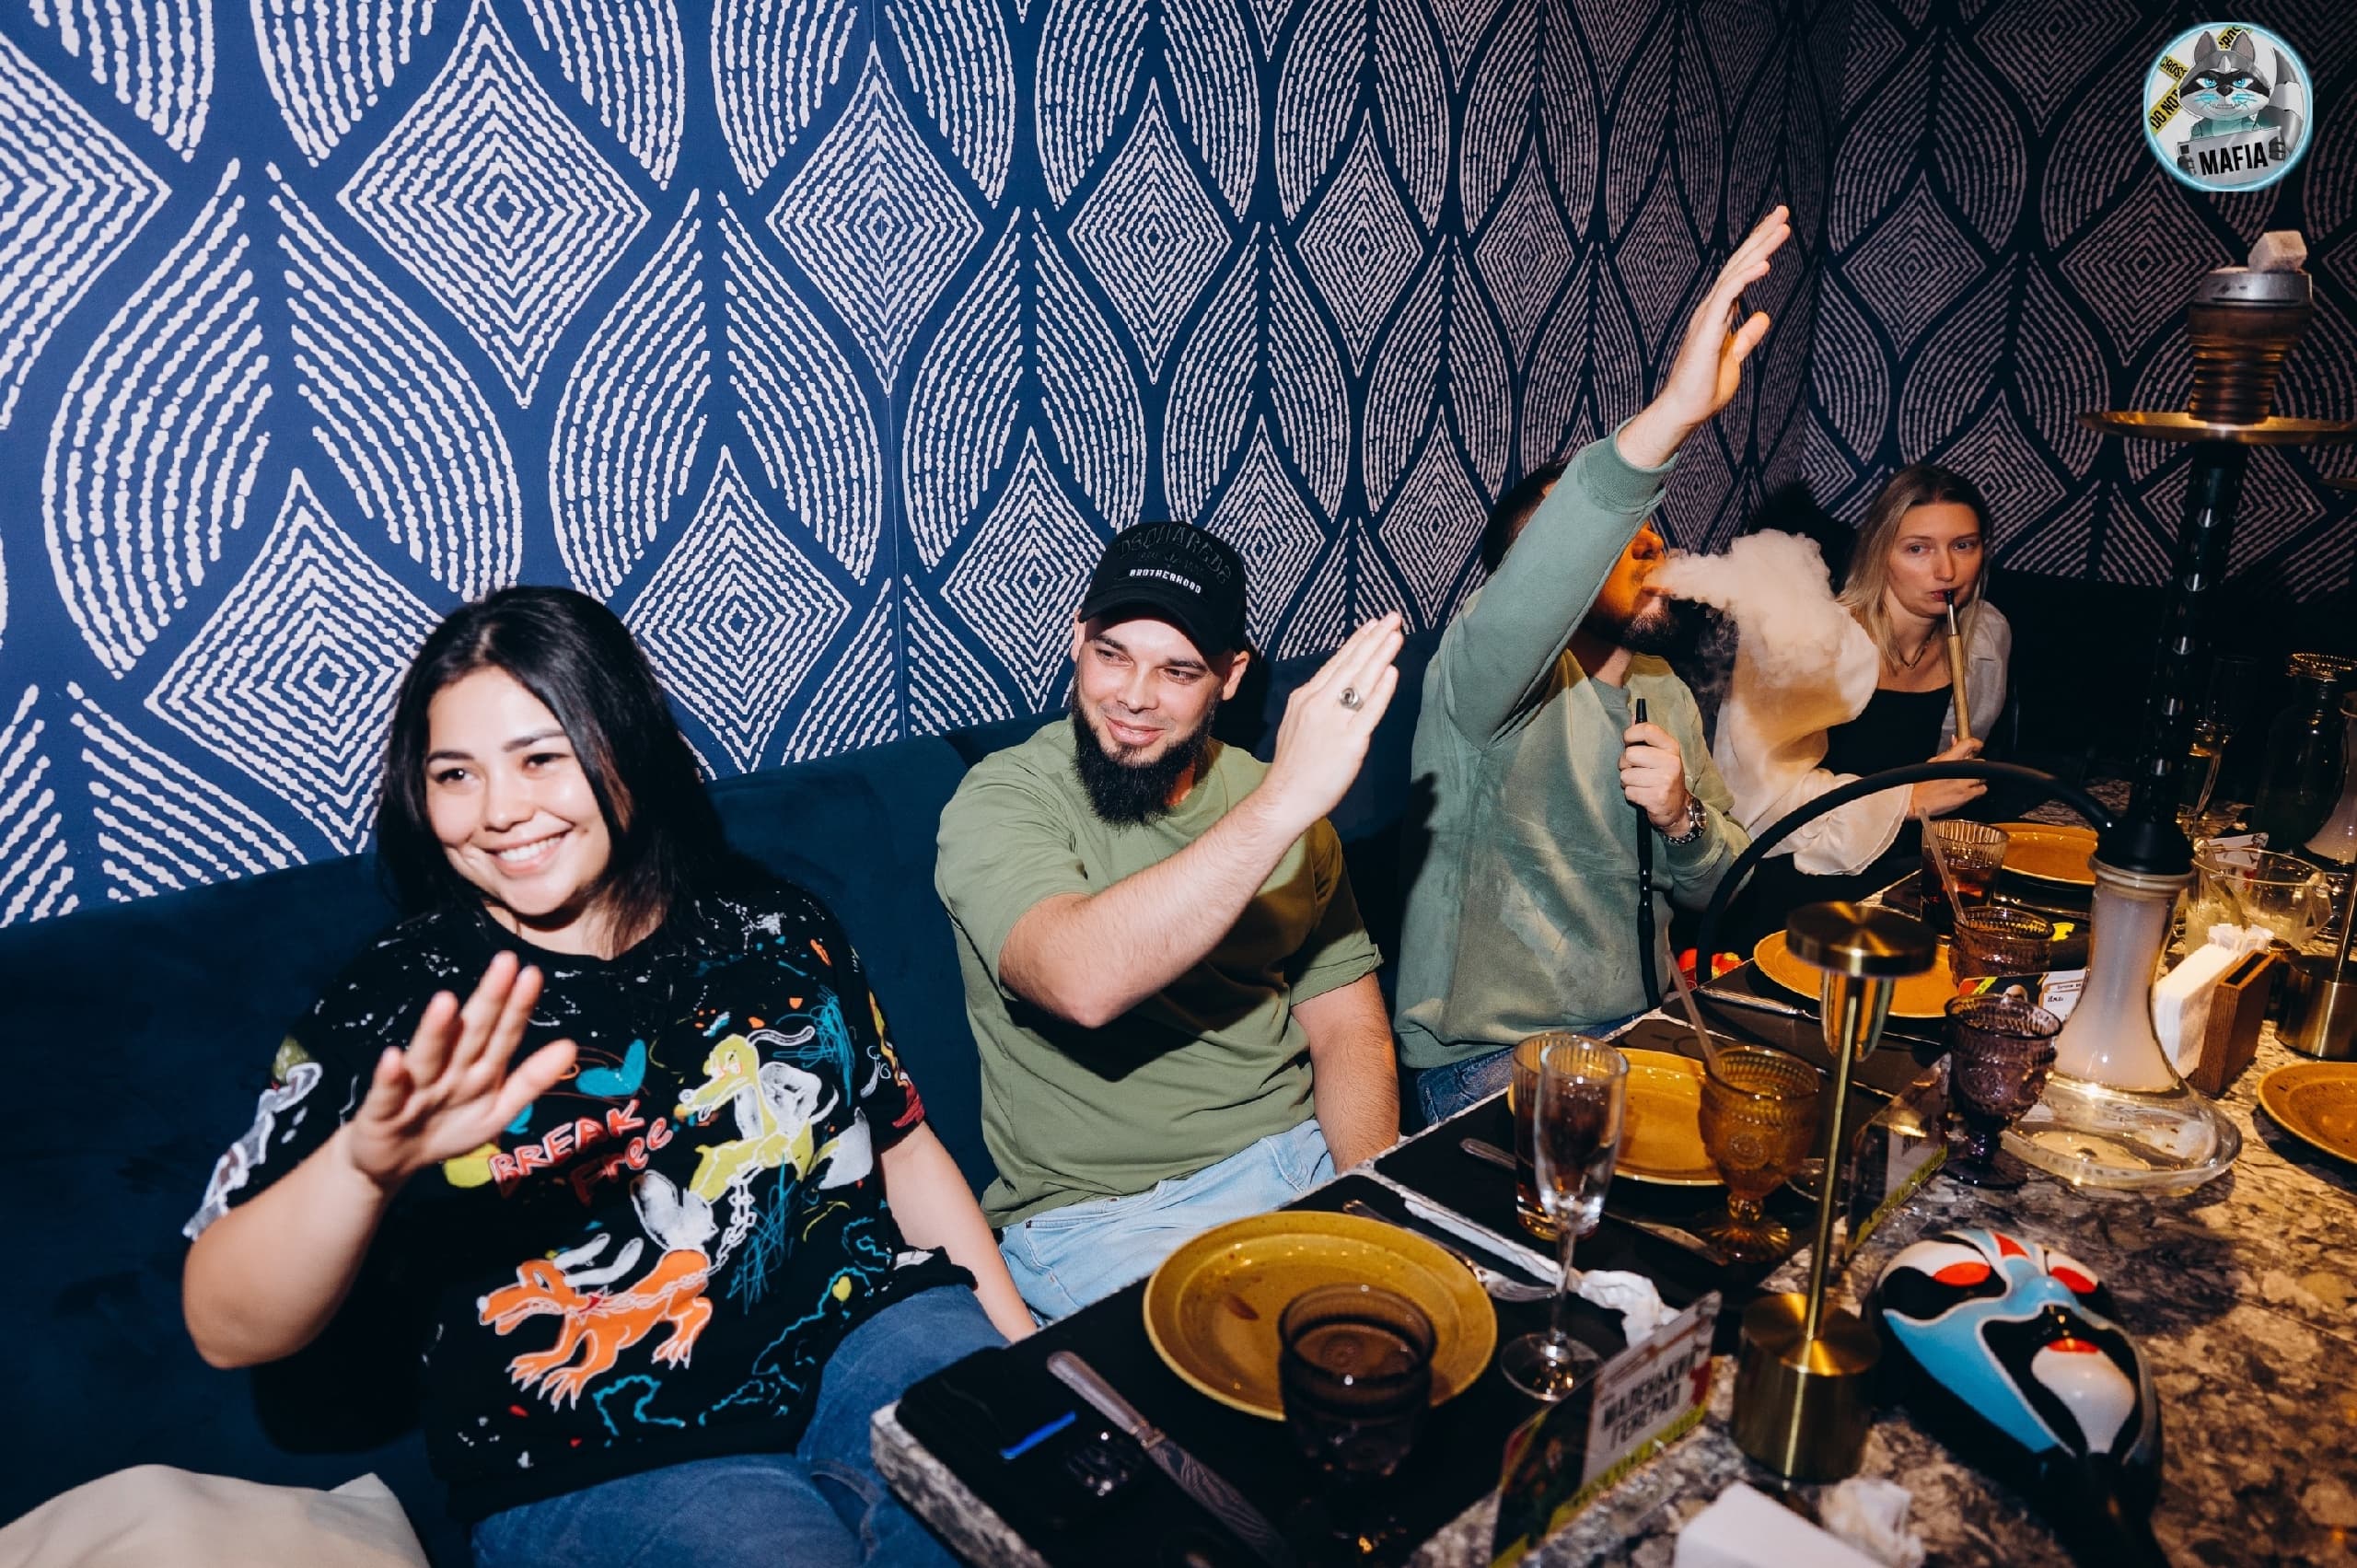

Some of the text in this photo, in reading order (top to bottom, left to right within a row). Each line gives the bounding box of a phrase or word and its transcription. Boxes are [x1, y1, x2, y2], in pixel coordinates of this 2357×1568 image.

[1129, 568, 1202, 594] BROTHERHOOD
[488, 1098, 645, 1193] BREAK
[570, 1117, 674, 1206] Free
